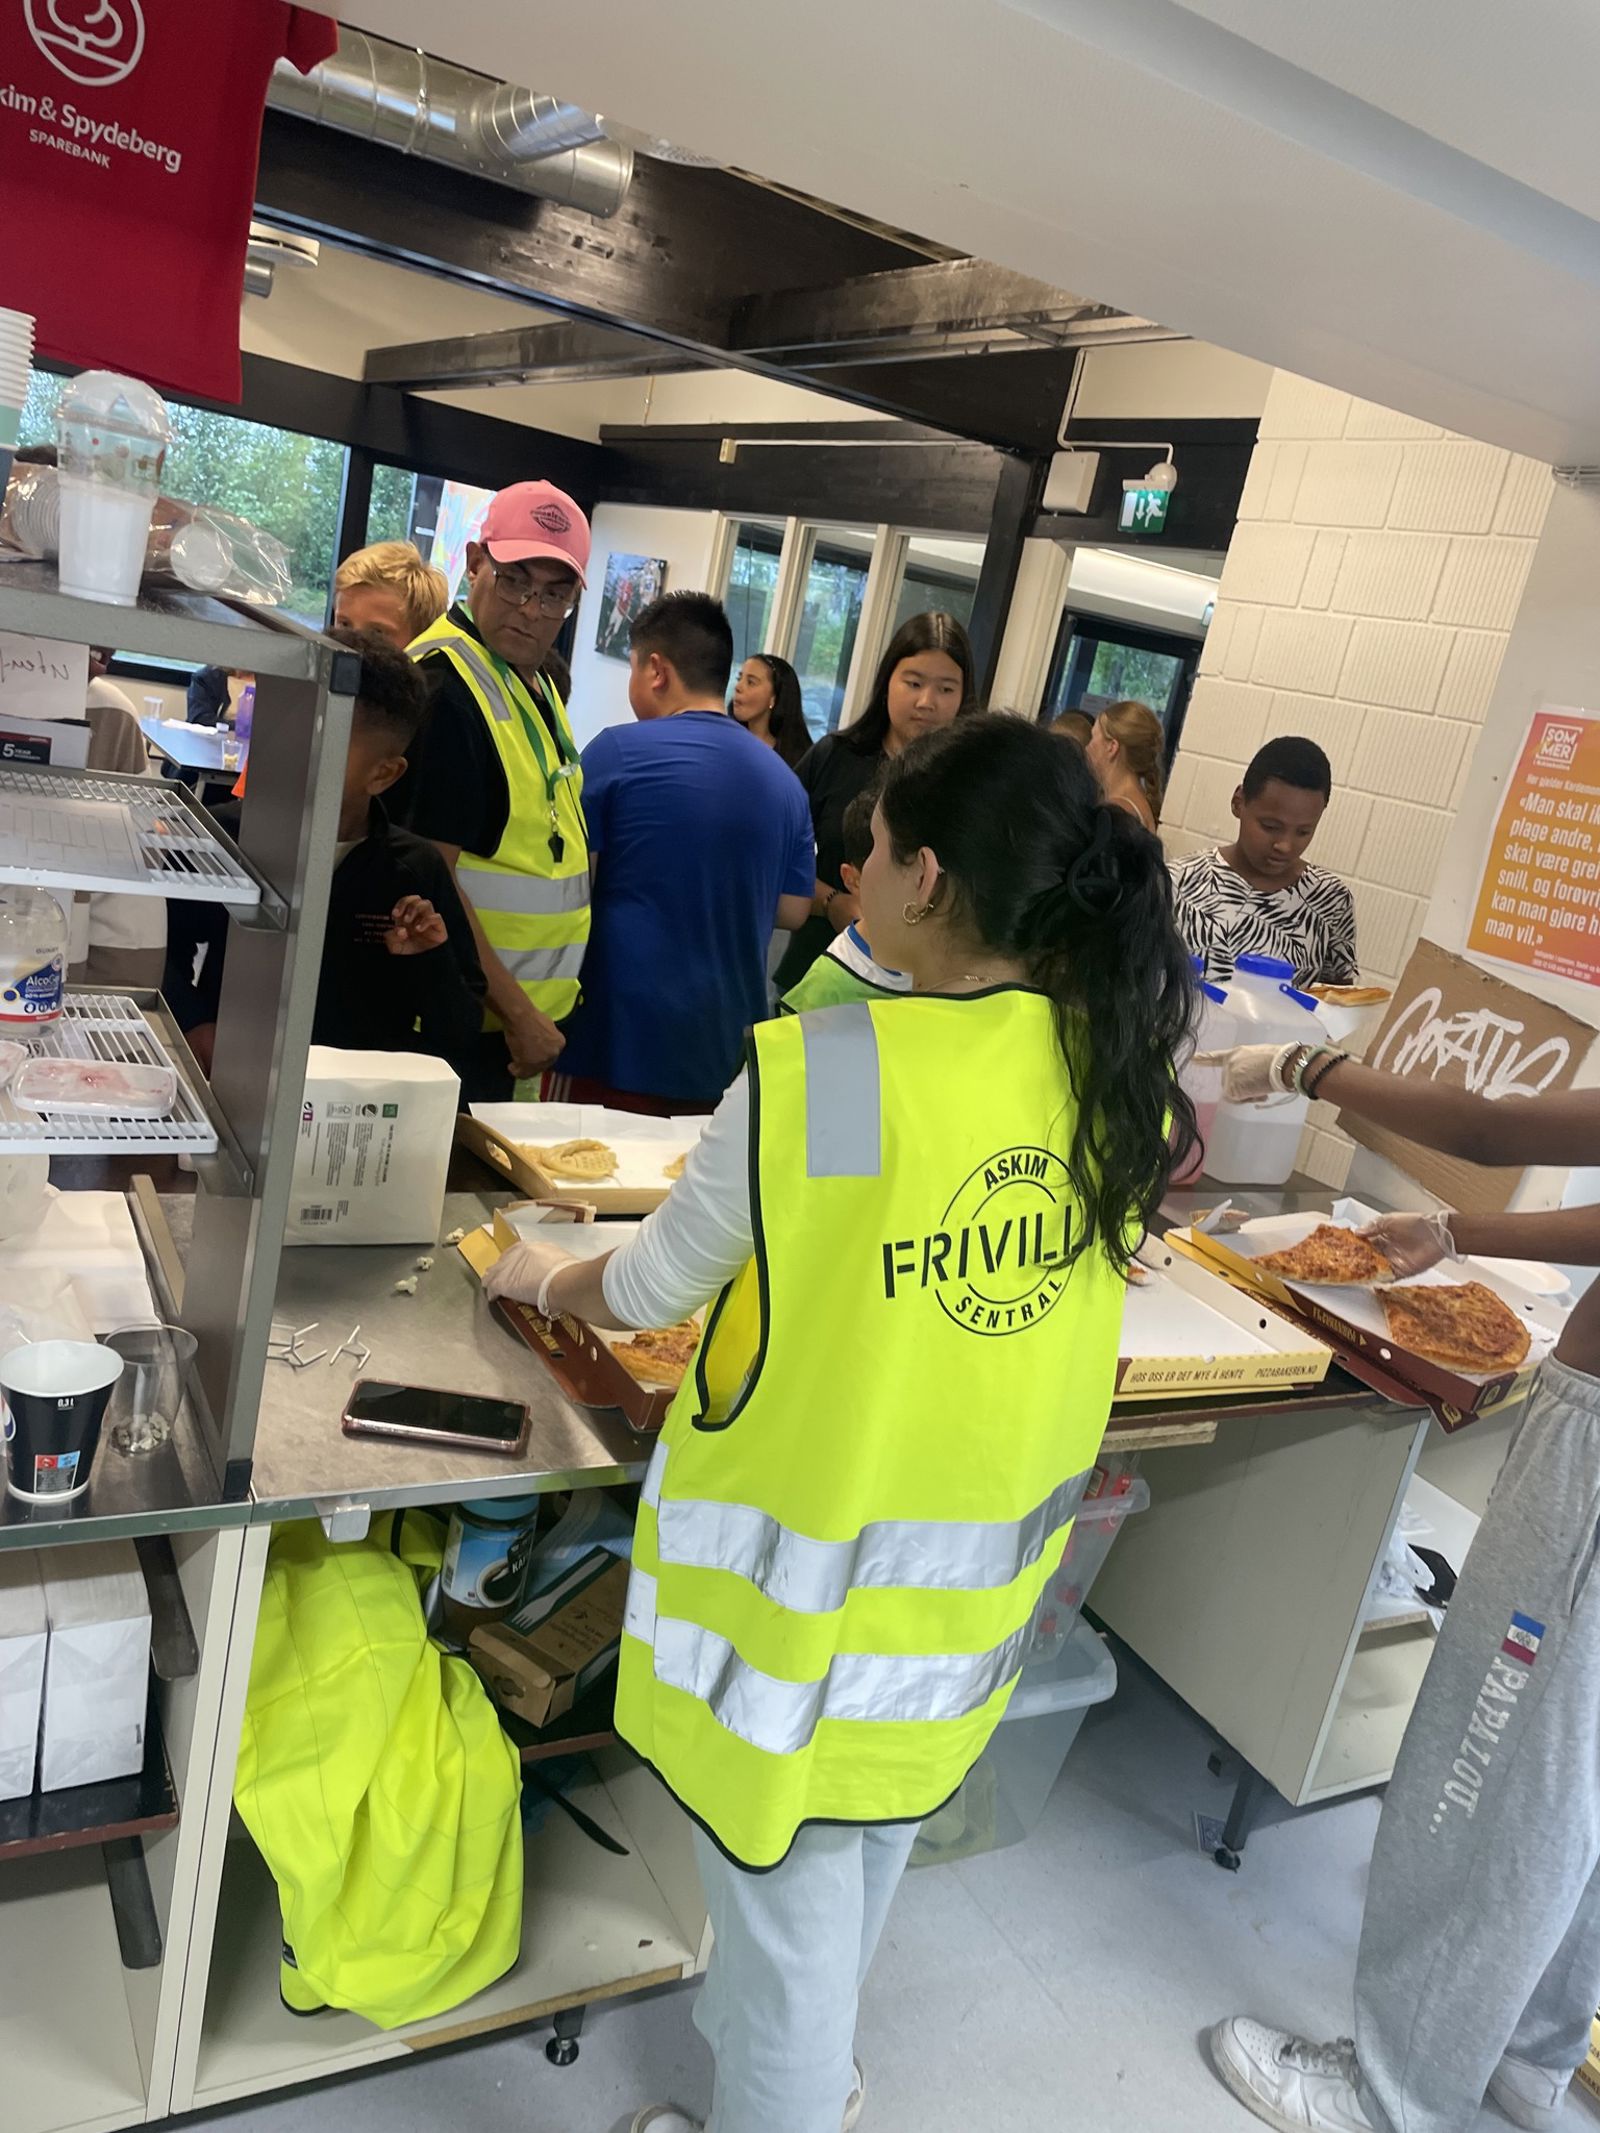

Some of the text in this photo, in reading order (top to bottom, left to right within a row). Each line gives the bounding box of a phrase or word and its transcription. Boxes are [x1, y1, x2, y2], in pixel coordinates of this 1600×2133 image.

[29, 128, 112, 169] SPAREBANK
[38, 96, 57, 122] &
[61, 103, 182, 174] Spydeberg
[2, 743, 15, 758] 5
[1540, 741, 1573, 759] MER
[1547, 727, 1578, 745] SOM
[1556, 799, 1588, 822] skal
[1509, 817, 1593, 853] plage andre,
[1504, 842, 1533, 865] skal
[1535, 851, 1569, 873] være
[1498, 868, 1600, 912] snill, og forøvri
[1485, 917, 1513, 940] man
[1491, 890, 1516, 914] kan
[1517, 901, 1547, 923] man
[1549, 908, 1586, 937] gjøre
[983, 1153, 1050, 1191] ASKIM
[882, 1204, 1105, 1300] FRIVILL
[955, 1278, 1063, 1329] SENTRAL
[1130, 1372, 1147, 1383] HOS
[1148, 1371, 1164, 1383] OSS
[1164, 1371, 1175, 1382] ER
[1176, 1370, 1191, 1381] DET
[1193, 1369, 1211, 1381] MYE
[1212, 1367, 1219, 1380] Å
[1219, 1368, 1245, 1380] HENTE
